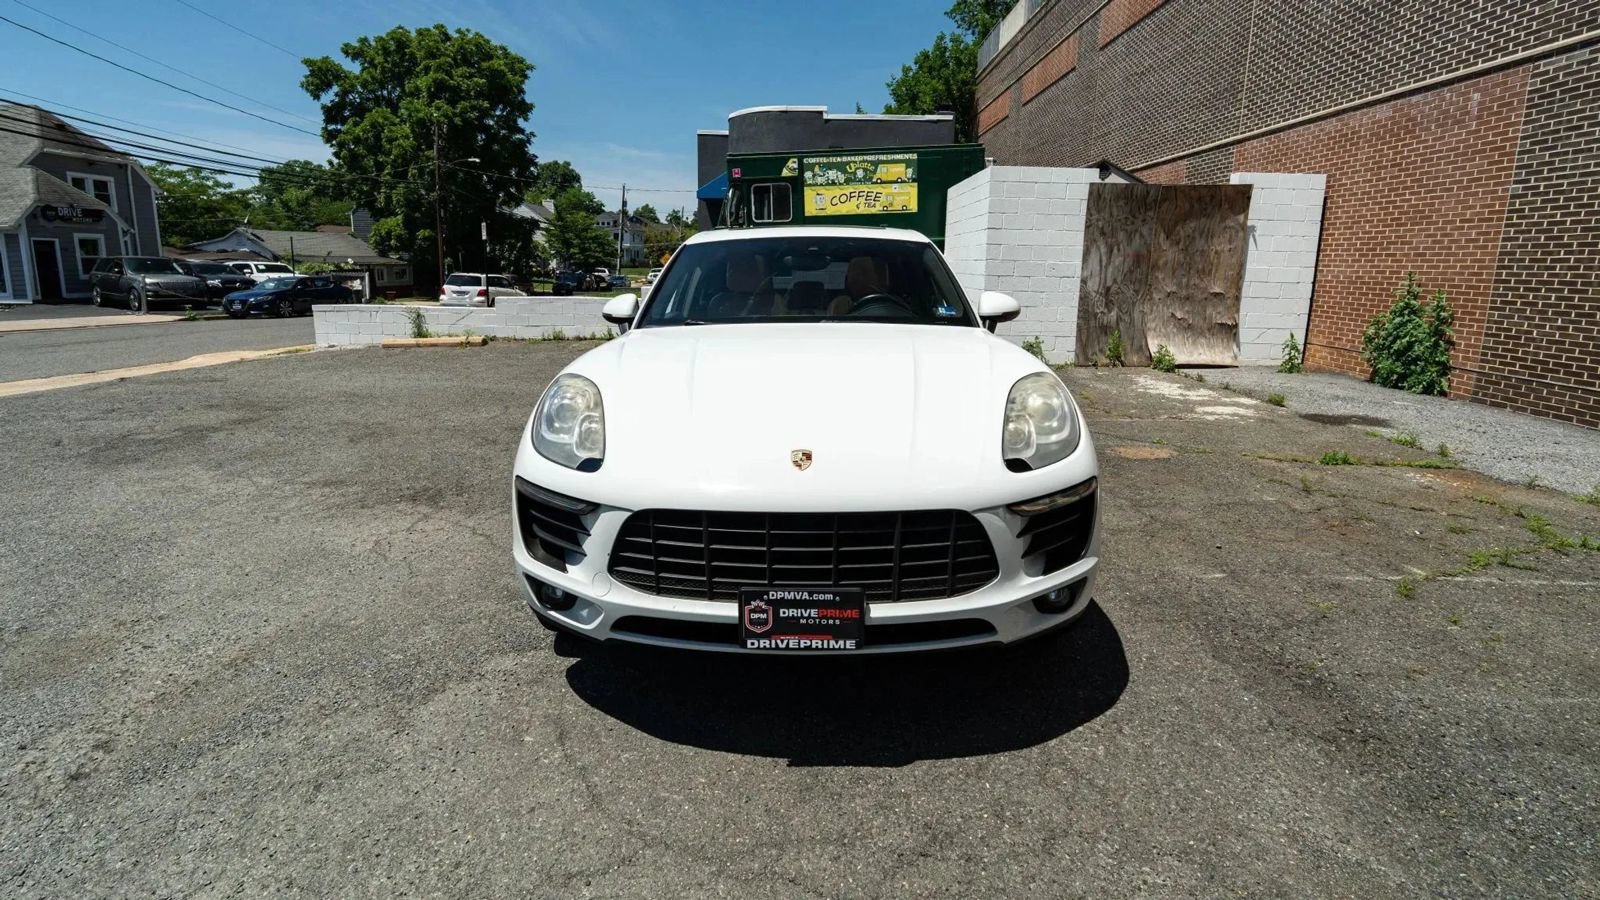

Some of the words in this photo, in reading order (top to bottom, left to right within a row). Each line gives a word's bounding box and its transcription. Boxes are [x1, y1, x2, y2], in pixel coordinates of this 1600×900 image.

[830, 190, 883, 206] COFFEE
[769, 591, 833, 600] DPMVA.com
[746, 639, 856, 649] DRIVEPRIME
